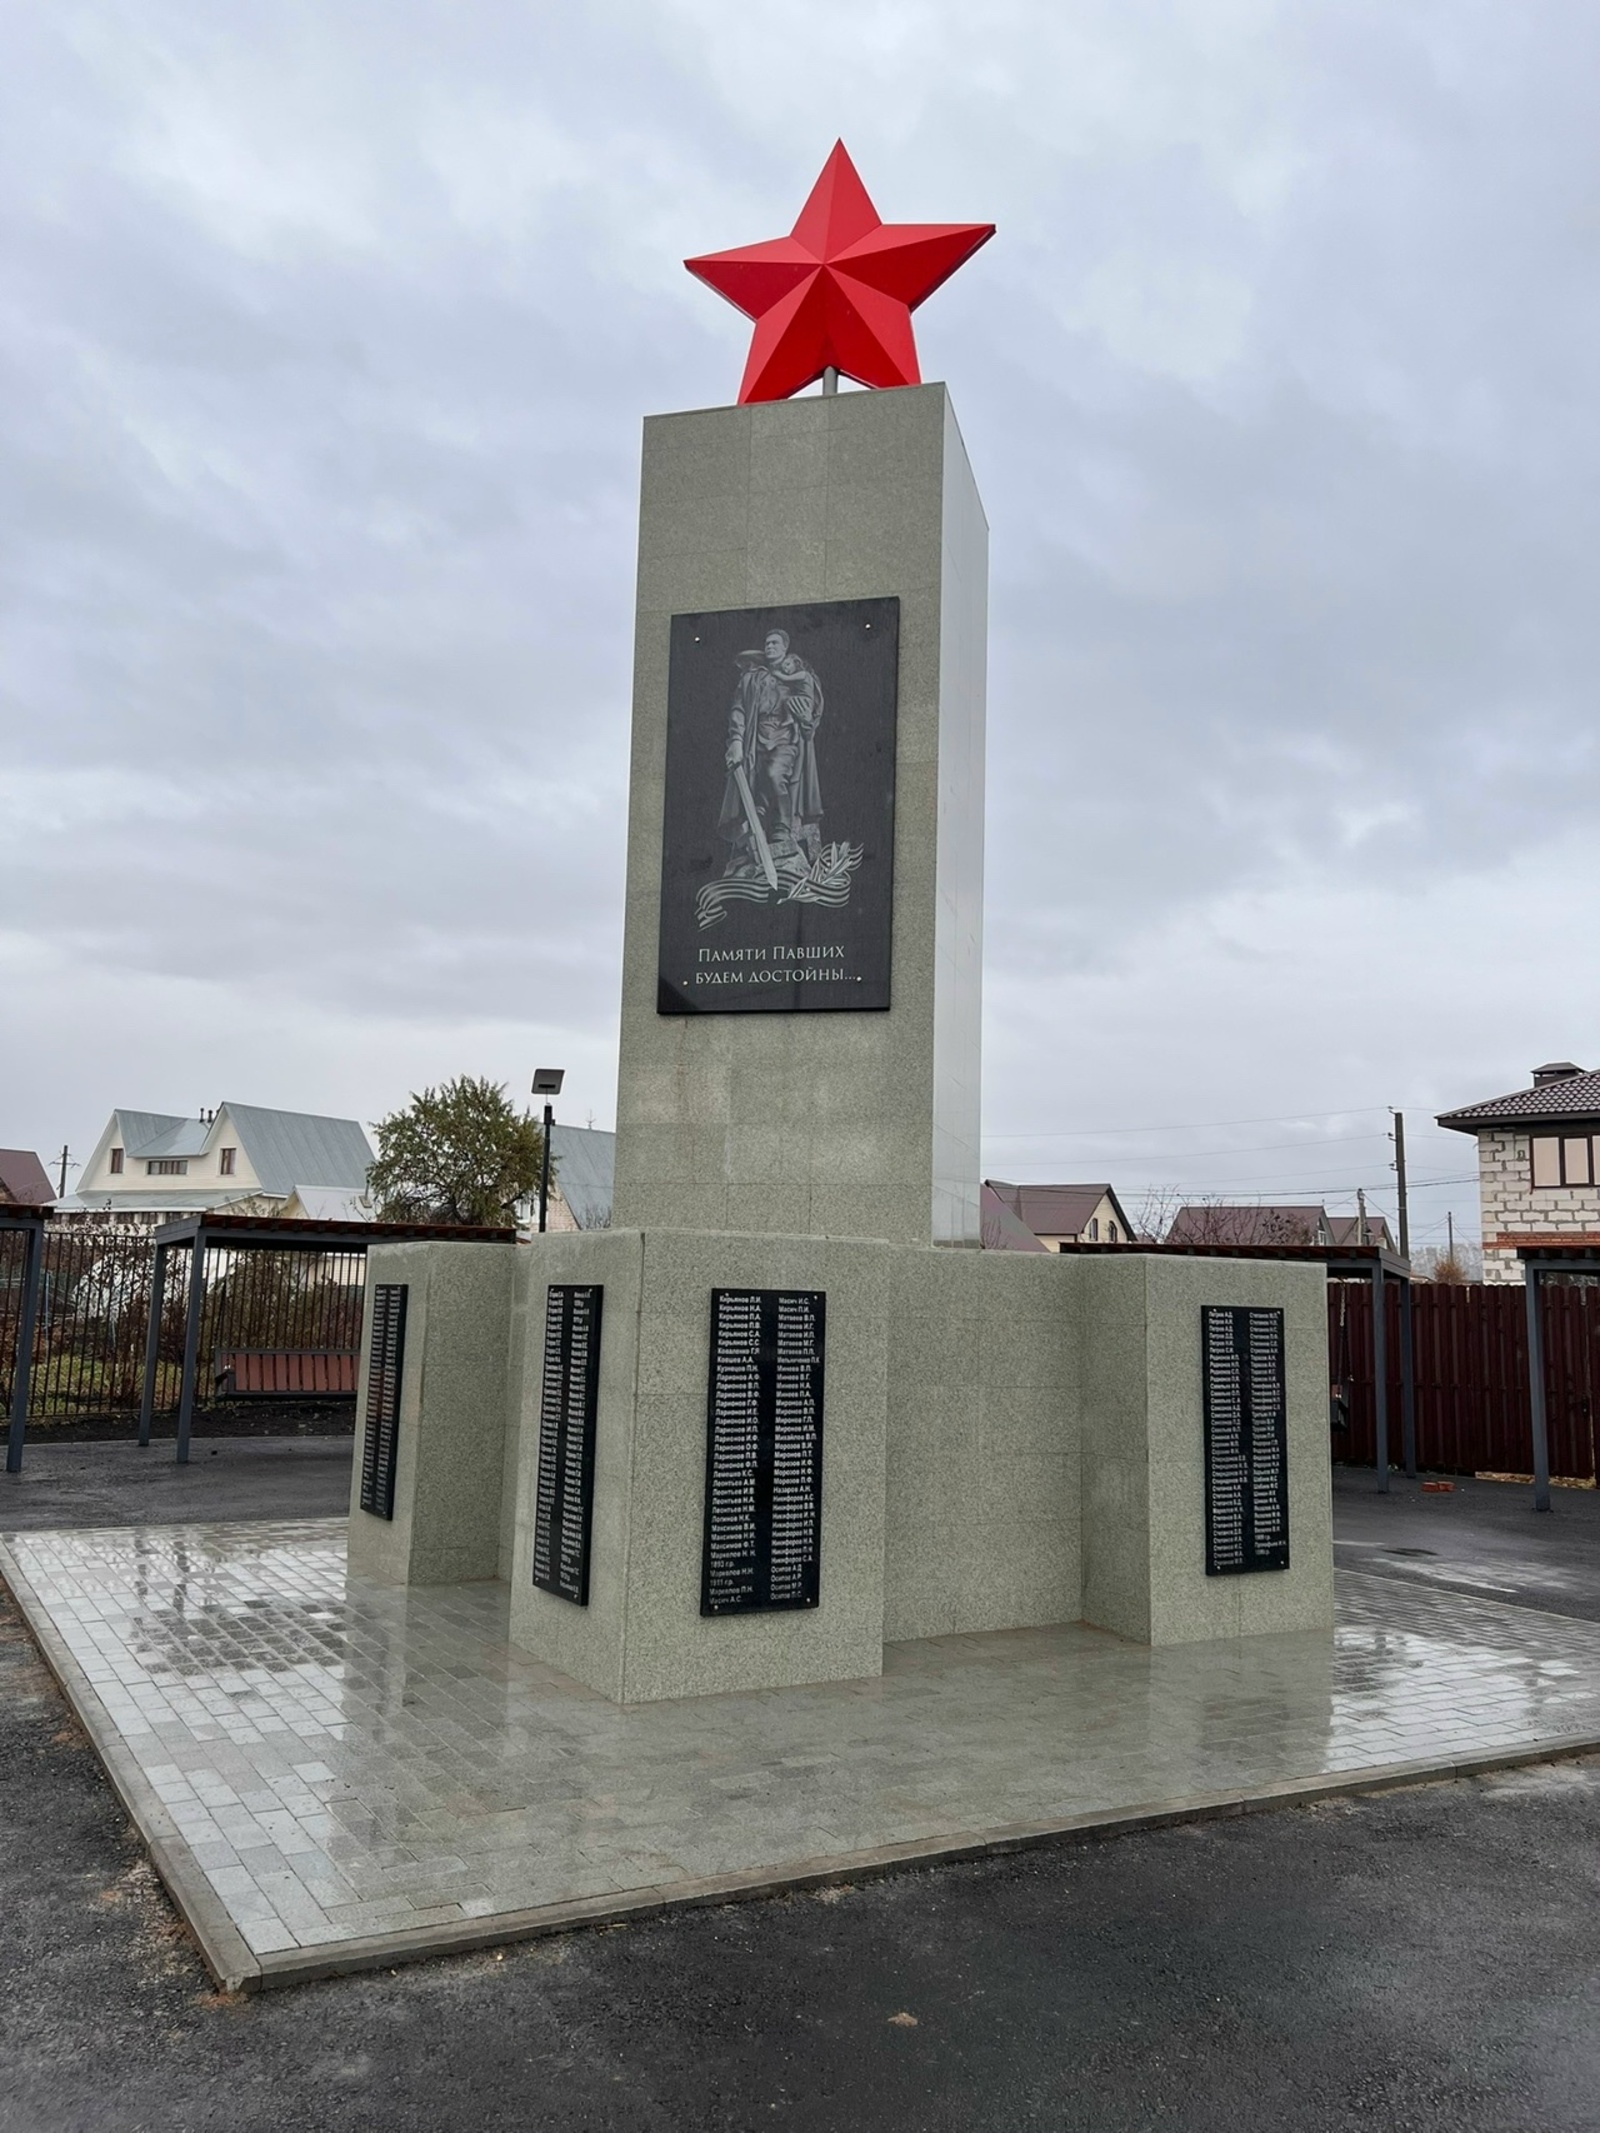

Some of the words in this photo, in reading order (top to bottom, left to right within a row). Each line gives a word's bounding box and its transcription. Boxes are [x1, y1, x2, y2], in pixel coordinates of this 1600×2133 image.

[699, 948, 766, 962] ПАМЯТИ
[773, 945, 845, 960] ПАВШИХ
[695, 971, 744, 985] БУДЕМ
